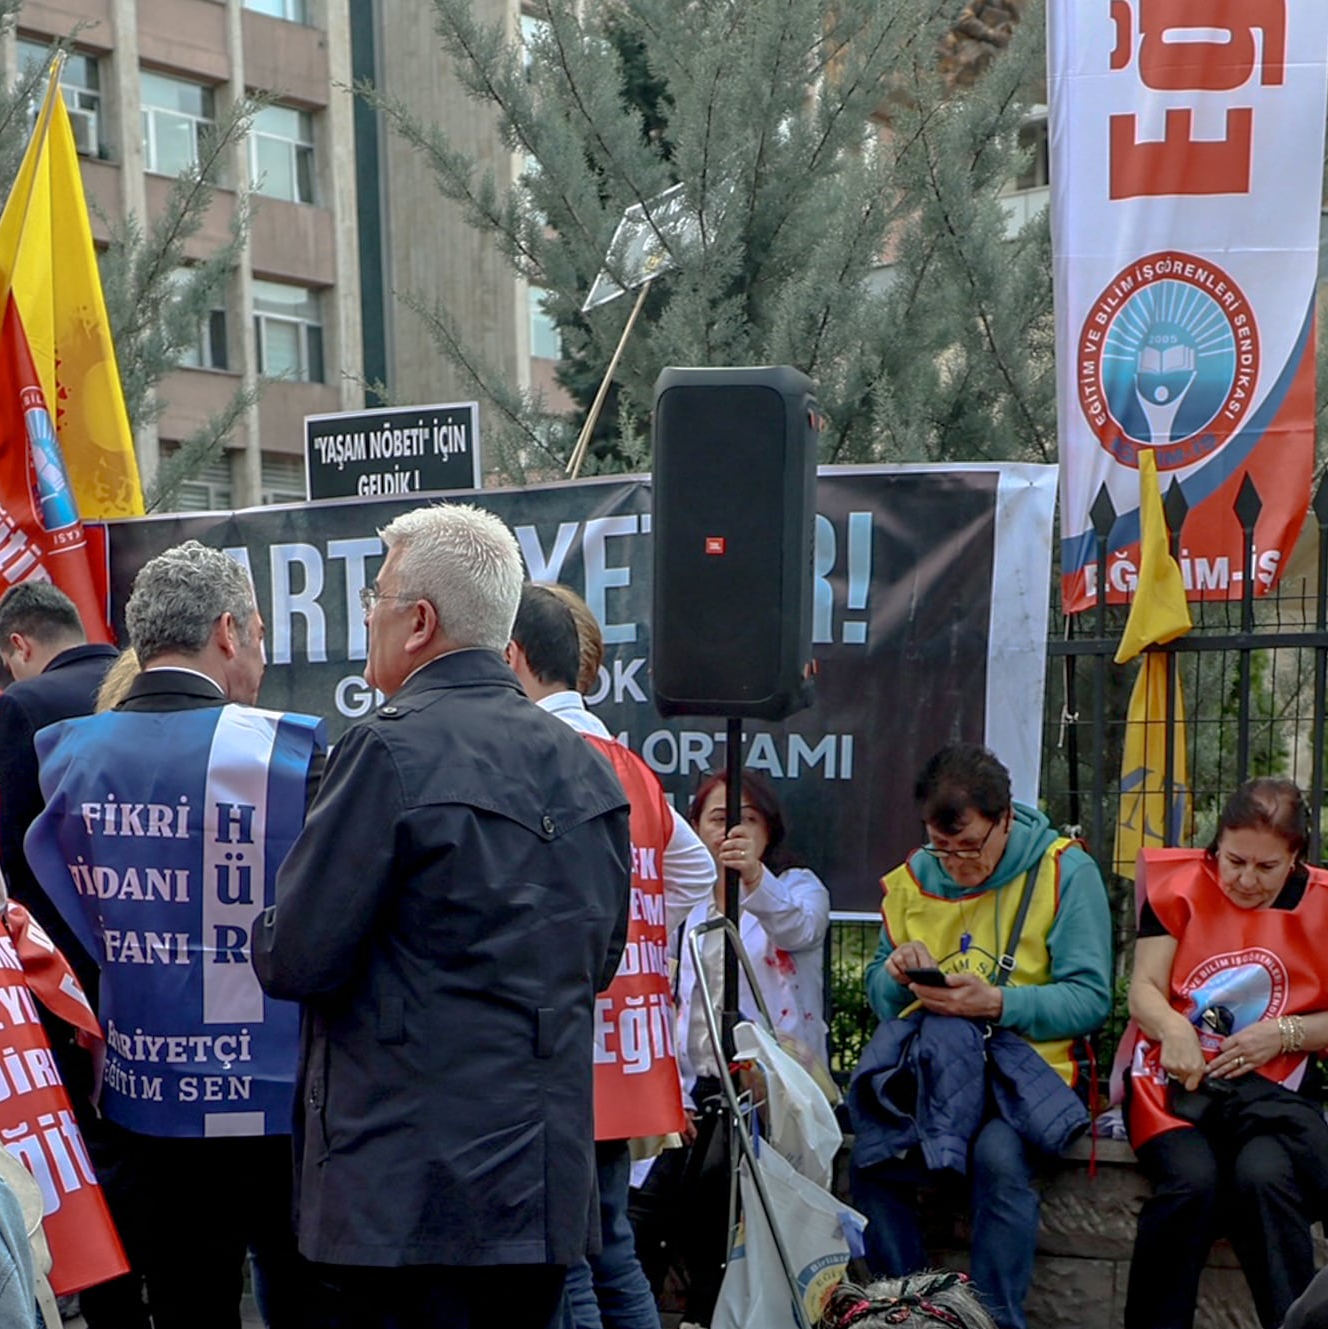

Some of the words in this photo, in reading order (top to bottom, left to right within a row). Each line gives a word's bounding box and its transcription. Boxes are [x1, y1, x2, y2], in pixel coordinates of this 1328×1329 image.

[1085, 329, 1102, 353] VE
[1095, 276, 1135, 325] BİLİM
[1224, 313, 1255, 420] SENDİKASI
[433, 417, 467, 462] İÇİN
[81, 793, 191, 839] FİKRİ
[179, 1076, 252, 1102] SEN
